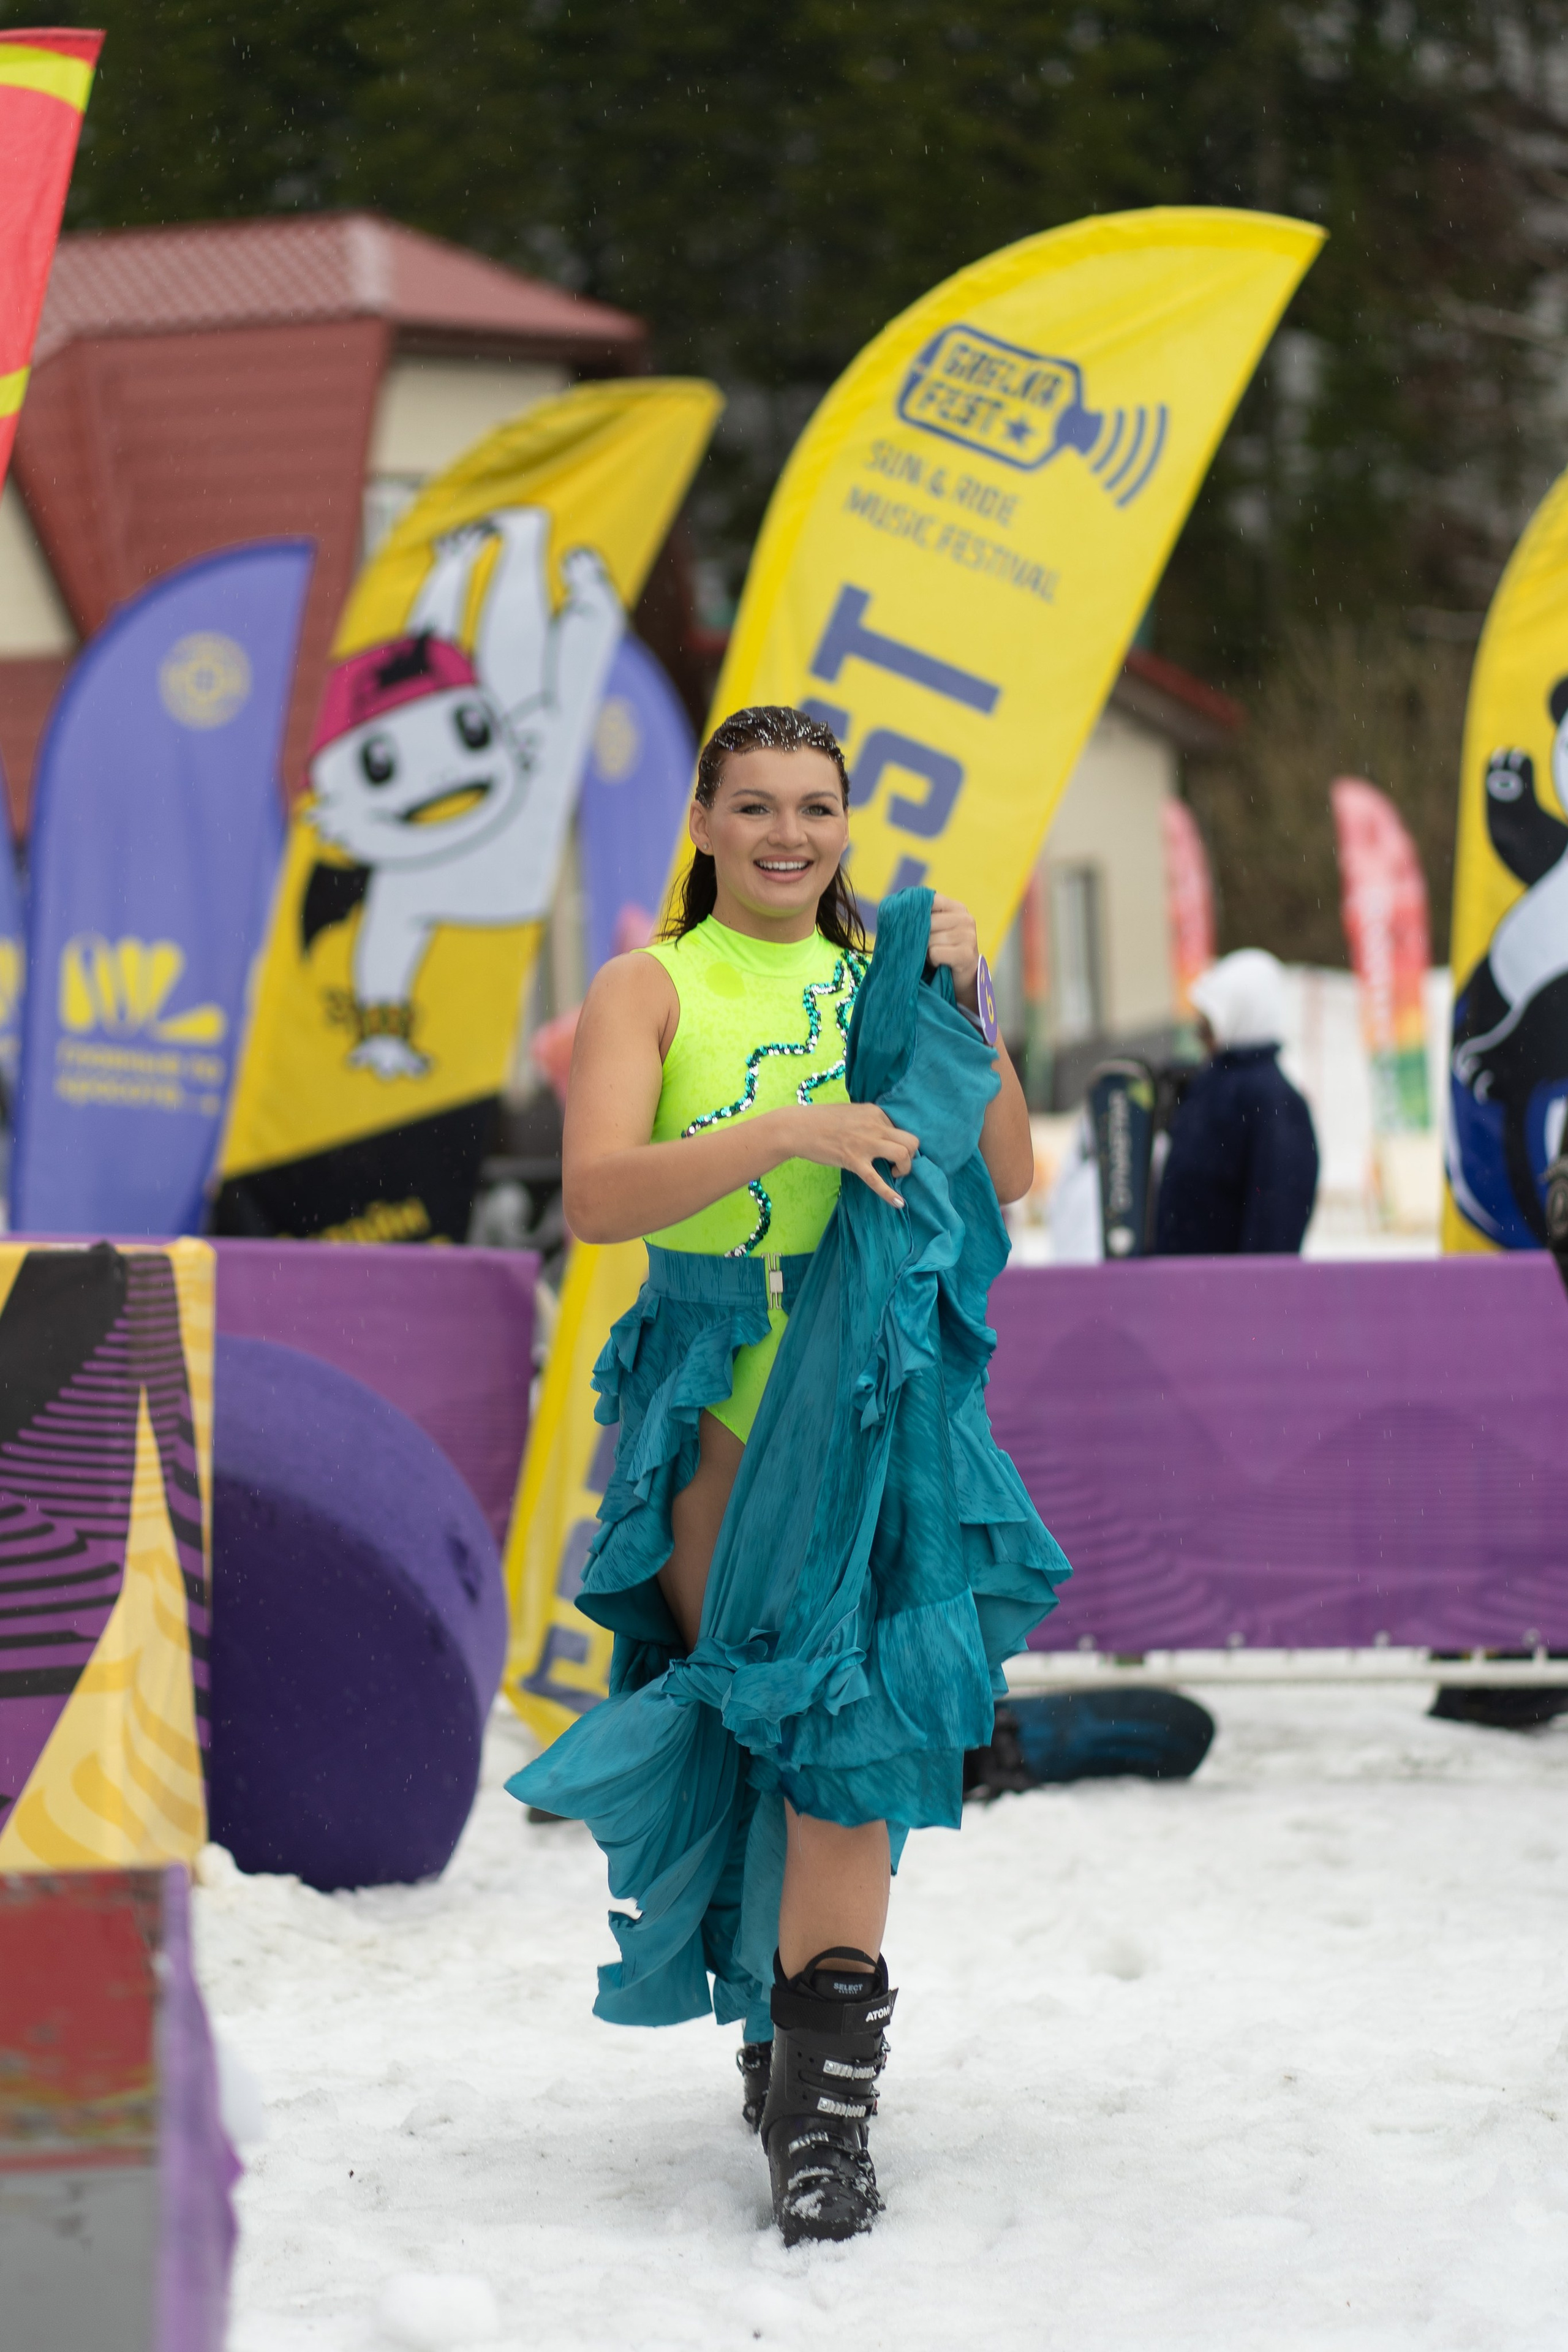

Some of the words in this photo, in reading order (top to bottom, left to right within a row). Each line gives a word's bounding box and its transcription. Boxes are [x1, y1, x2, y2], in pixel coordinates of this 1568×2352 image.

[918, 382, 1005, 434] FEST
[865, 440, 924, 485] SUN
[926, 467, 946, 499] &
[956, 475, 1017, 527] RIDE
[846, 486, 935, 546] MUSIC
[937, 524, 1058, 604] FESTIVAL
[833, 1982, 863, 1991] SELECT
